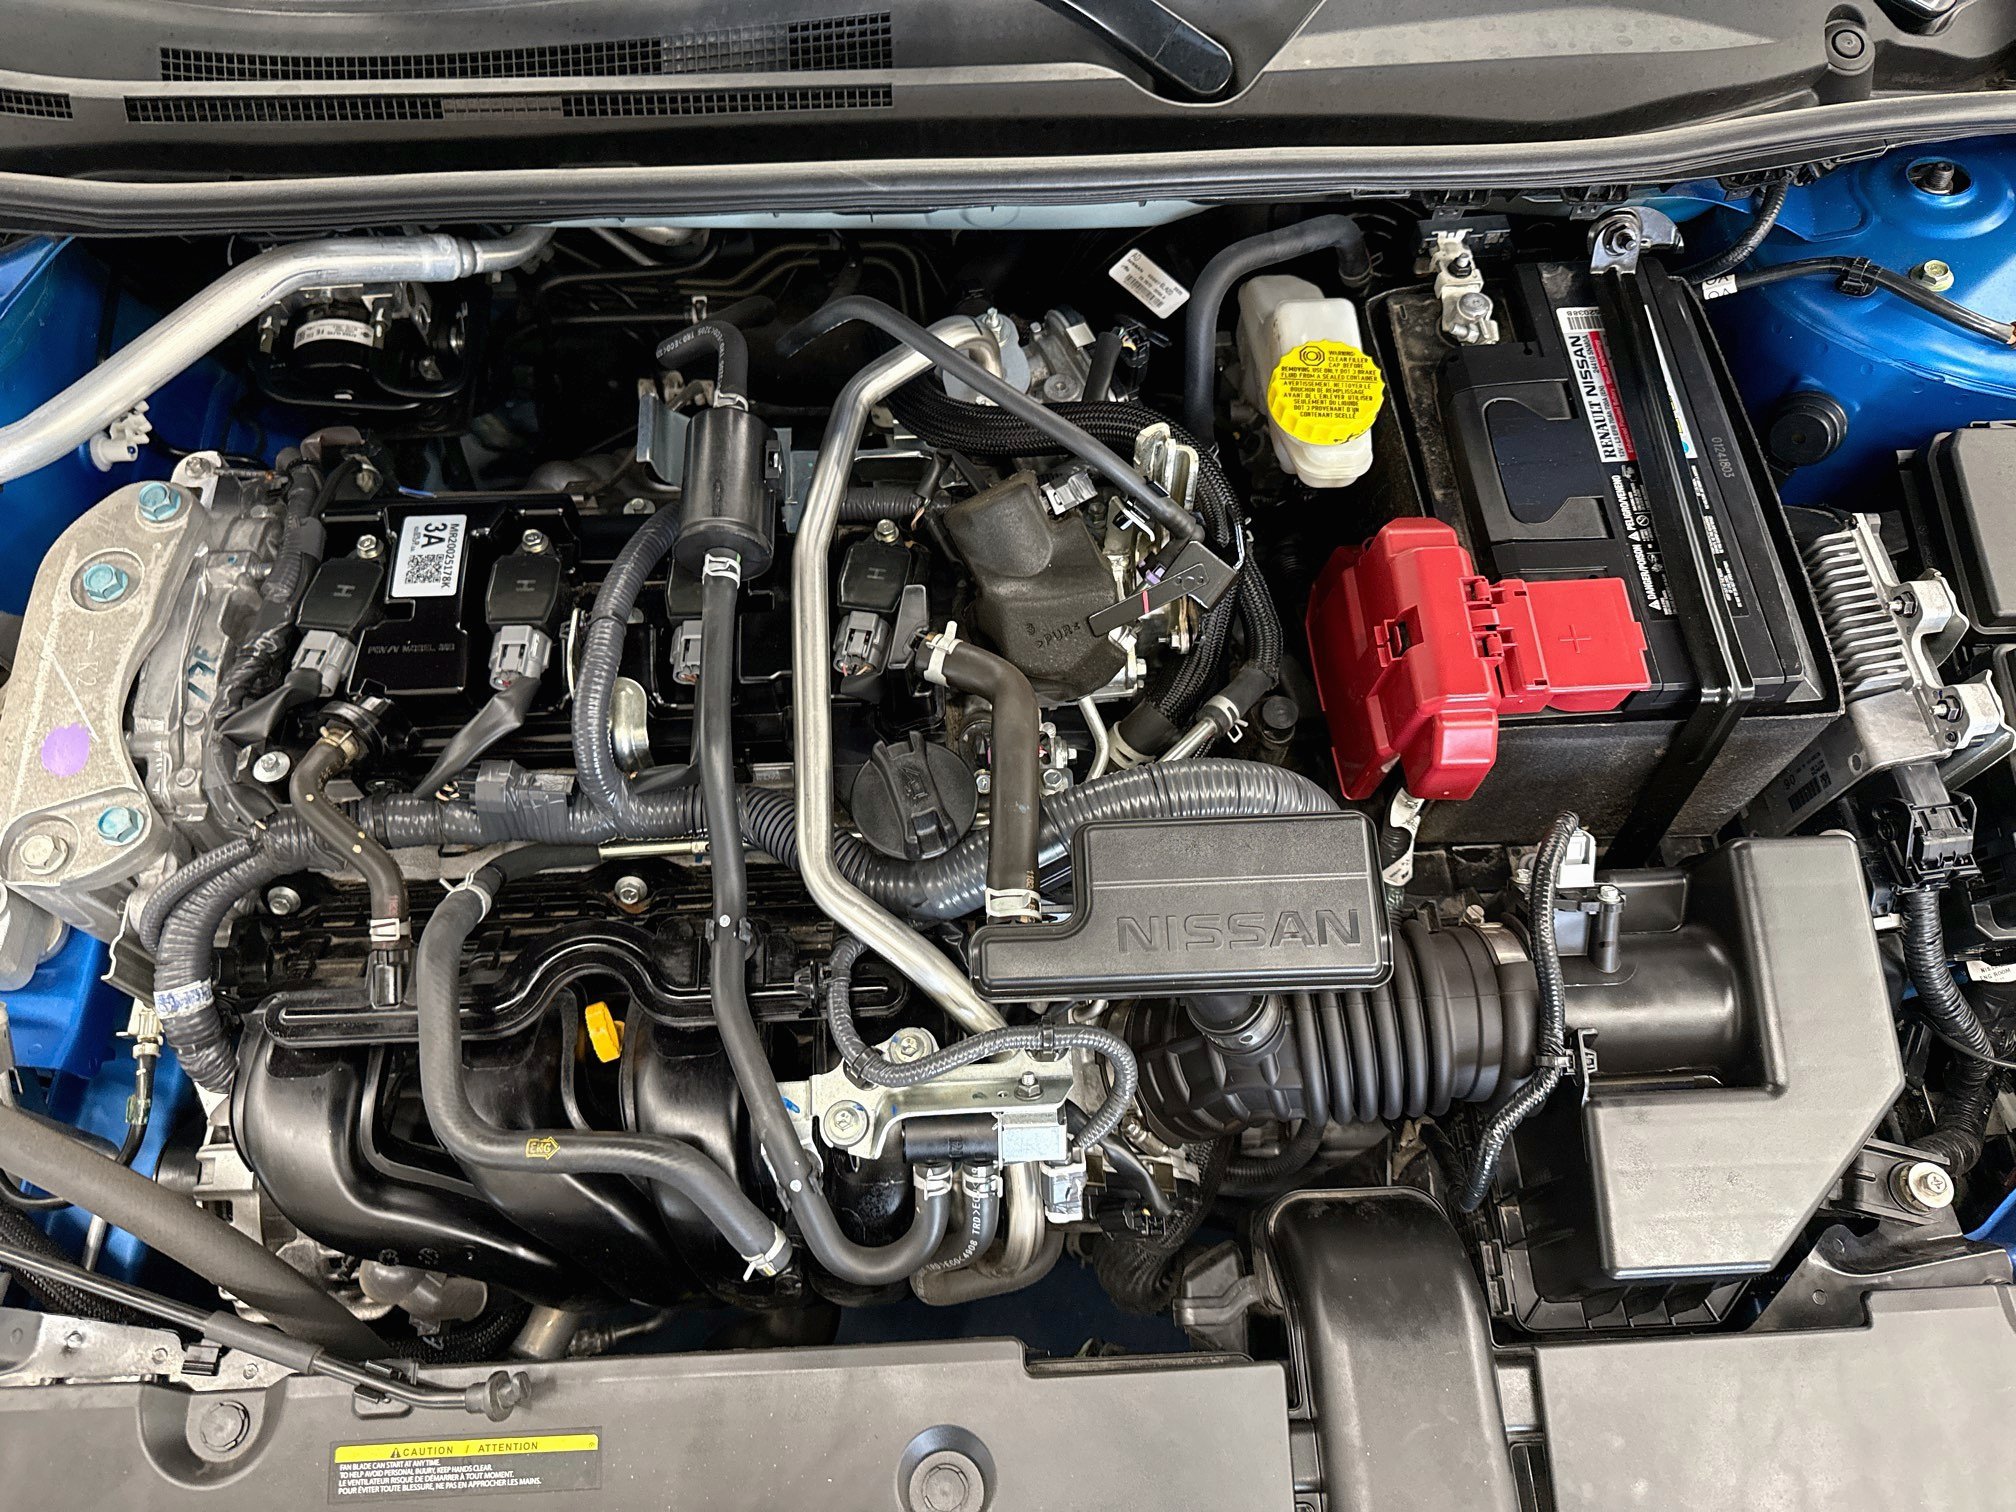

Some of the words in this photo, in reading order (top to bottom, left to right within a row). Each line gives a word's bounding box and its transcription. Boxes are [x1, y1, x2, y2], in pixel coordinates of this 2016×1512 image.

[1568, 335, 1598, 397] NISSAN
[1589, 401, 1617, 459] RENAULT
[421, 522, 448, 549] 3A
[441, 523, 460, 589] MR20025178K
[1117, 908, 1362, 952] NISSAN
[403, 1446, 453, 1457] CAUTION
[478, 1442, 538, 1453] ATTENTION
[340, 1463, 352, 1471] FAN
[353, 1462, 371, 1470] BLADE
[373, 1461, 385, 1469] CAN
[386, 1460, 403, 1468] START
[365, 1469, 383, 1477] AVOID
[384, 1468, 414, 1476] PERSONAL
[338, 1487, 357, 1495] POUR
[381, 1484, 401, 1492] TOUTE
[436, 1482, 444, 1490] NE
[446, 1481, 457, 1489] PAS
[458, 1481, 467, 1489] EN
[468, 1480, 507, 1488] APPROCHER
[348, 1477, 389, 1486] VENTILATEUR
[390, 1476, 413, 1485] RISQUE
[466, 1472, 483, 1480] TOUT
